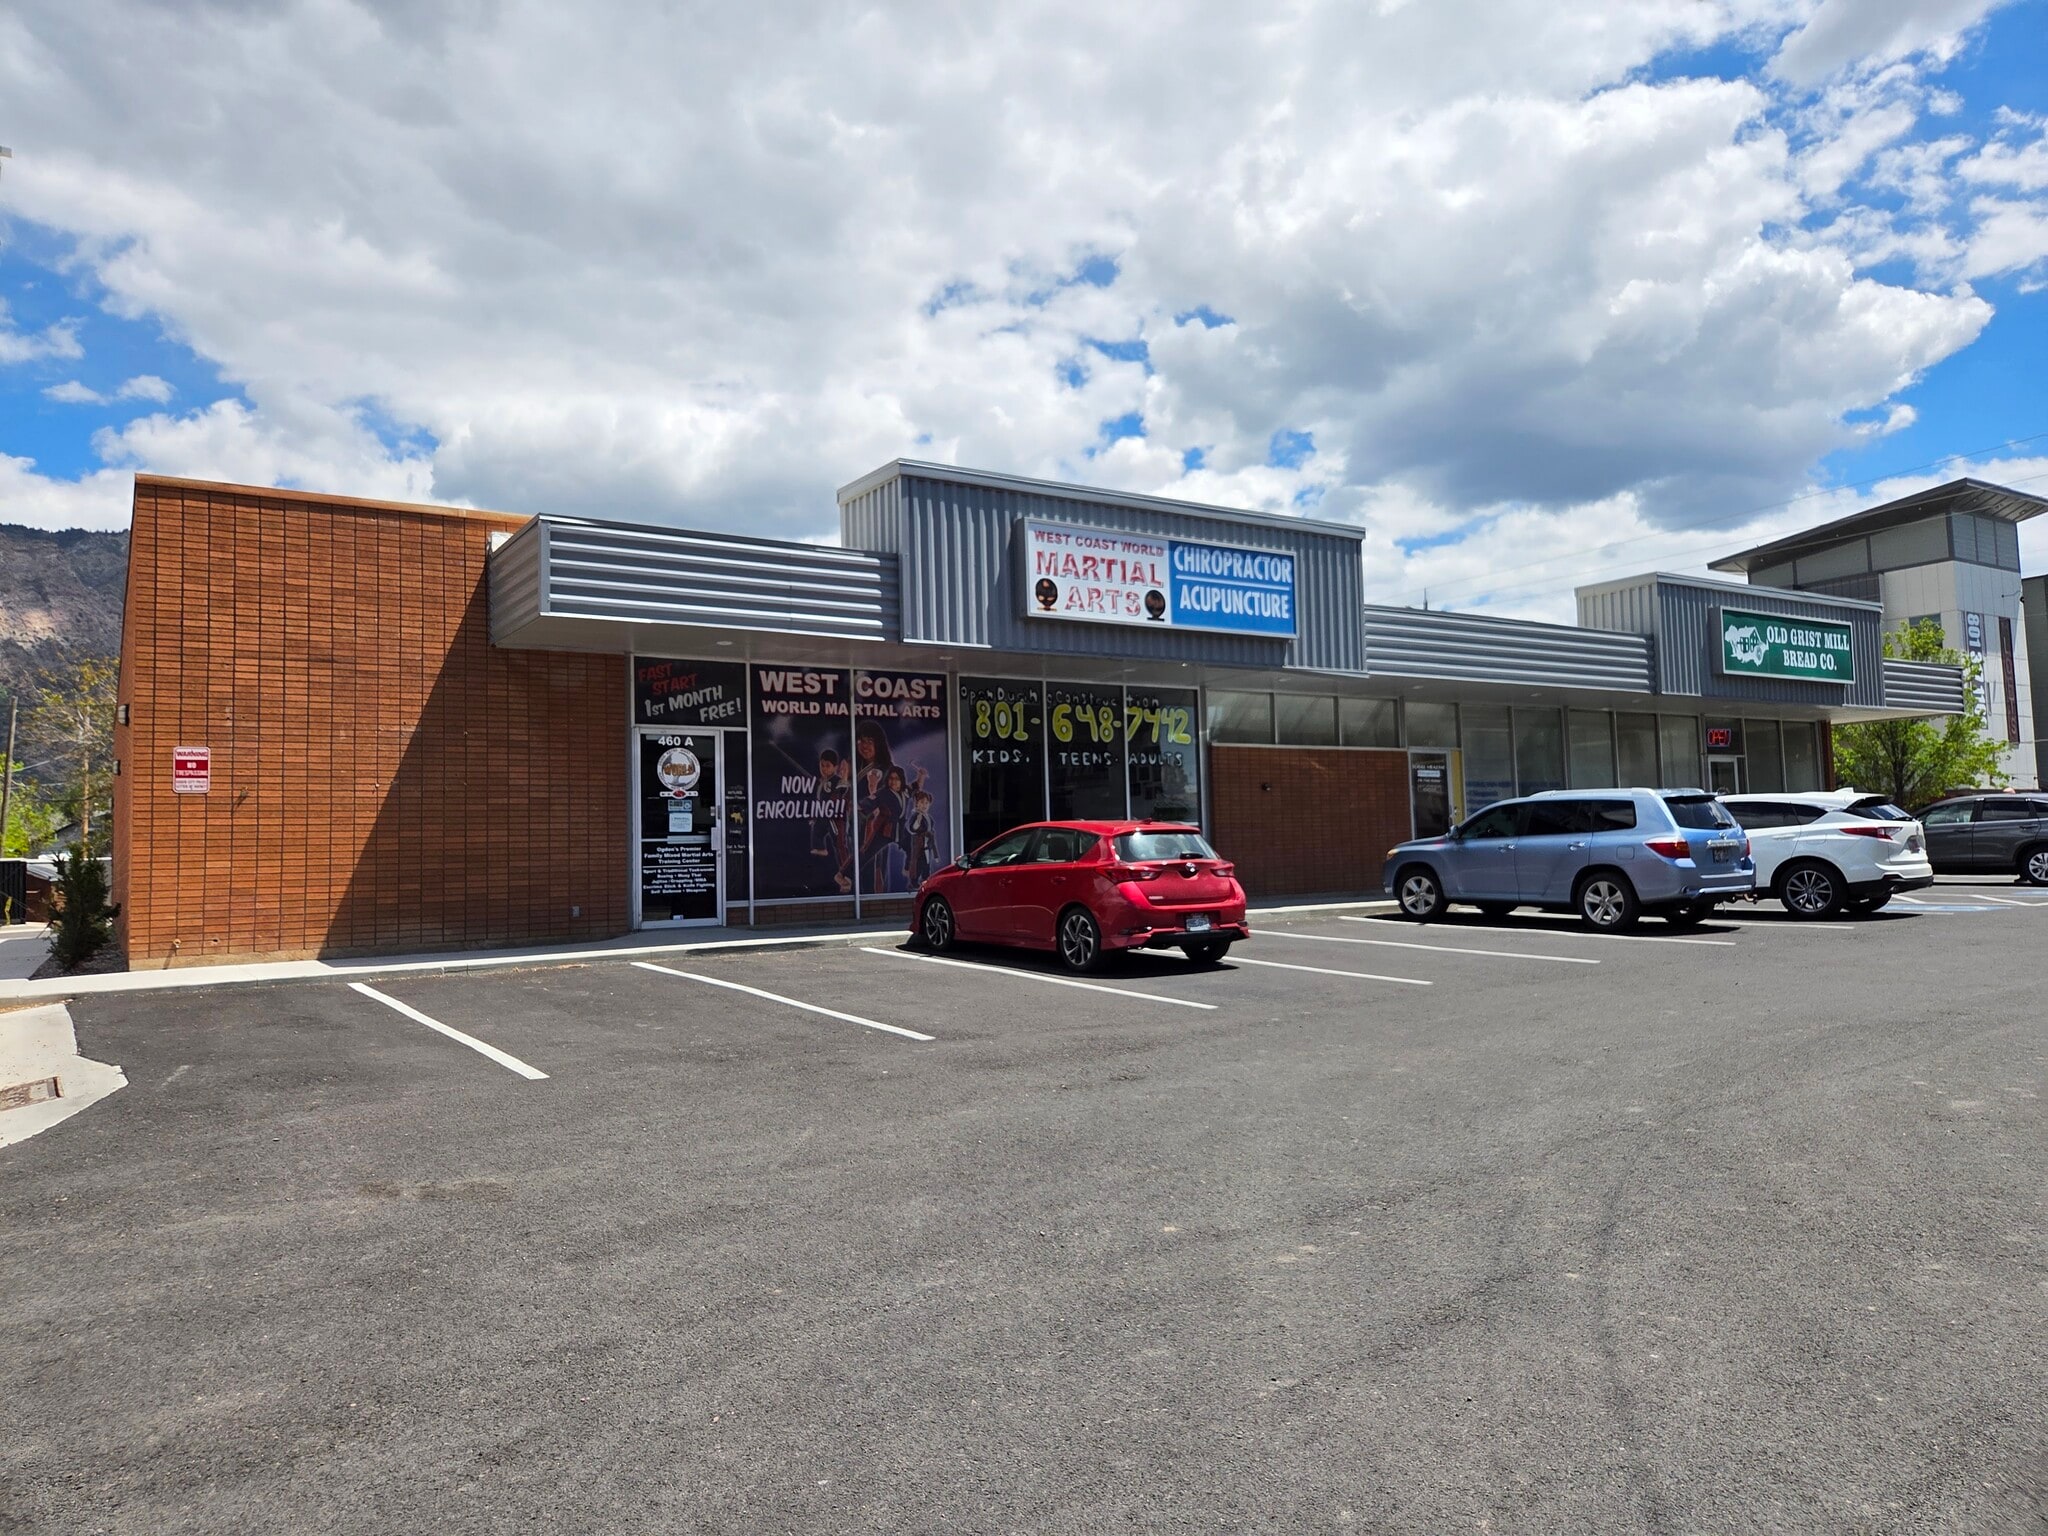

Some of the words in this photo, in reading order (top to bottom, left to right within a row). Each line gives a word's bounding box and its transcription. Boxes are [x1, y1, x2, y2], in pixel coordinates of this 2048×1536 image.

[1034, 530, 1070, 546] WEST
[1075, 536, 1117, 550] COAST
[1121, 541, 1164, 557] WORLD
[1036, 551, 1164, 588] MARTIAL
[1173, 545, 1292, 583] CHIROPRACTOR
[1064, 586, 1141, 616] ARTS
[1180, 584, 1290, 619] ACUPUNCTURE
[1767, 626, 1788, 644] OLD
[1790, 628, 1822, 648] GRIST
[1824, 633, 1849, 651] MILL
[638, 662, 672, 680] FAST
[1783, 650, 1817, 669] BREAD
[1820, 653, 1837, 671] CO.
[652, 673, 697, 695] START
[759, 670, 839, 694] WEST
[856, 676, 942, 700] COAST
[668, 685, 723, 711] MONTH
[699, 697, 741, 722] FREE!
[762, 700, 820, 714] WORLD
[825, 702, 898, 717] MARTIAL
[902, 705, 941, 718] ARTS
[658, 736, 681, 746] 460
[684, 737, 694, 746] A
[187, 761, 197, 769] NO
[1128, 752, 1182, 766] ADULTS
[781, 776, 817, 794] NOW
[756, 799, 845, 819] ENROLLING!!
